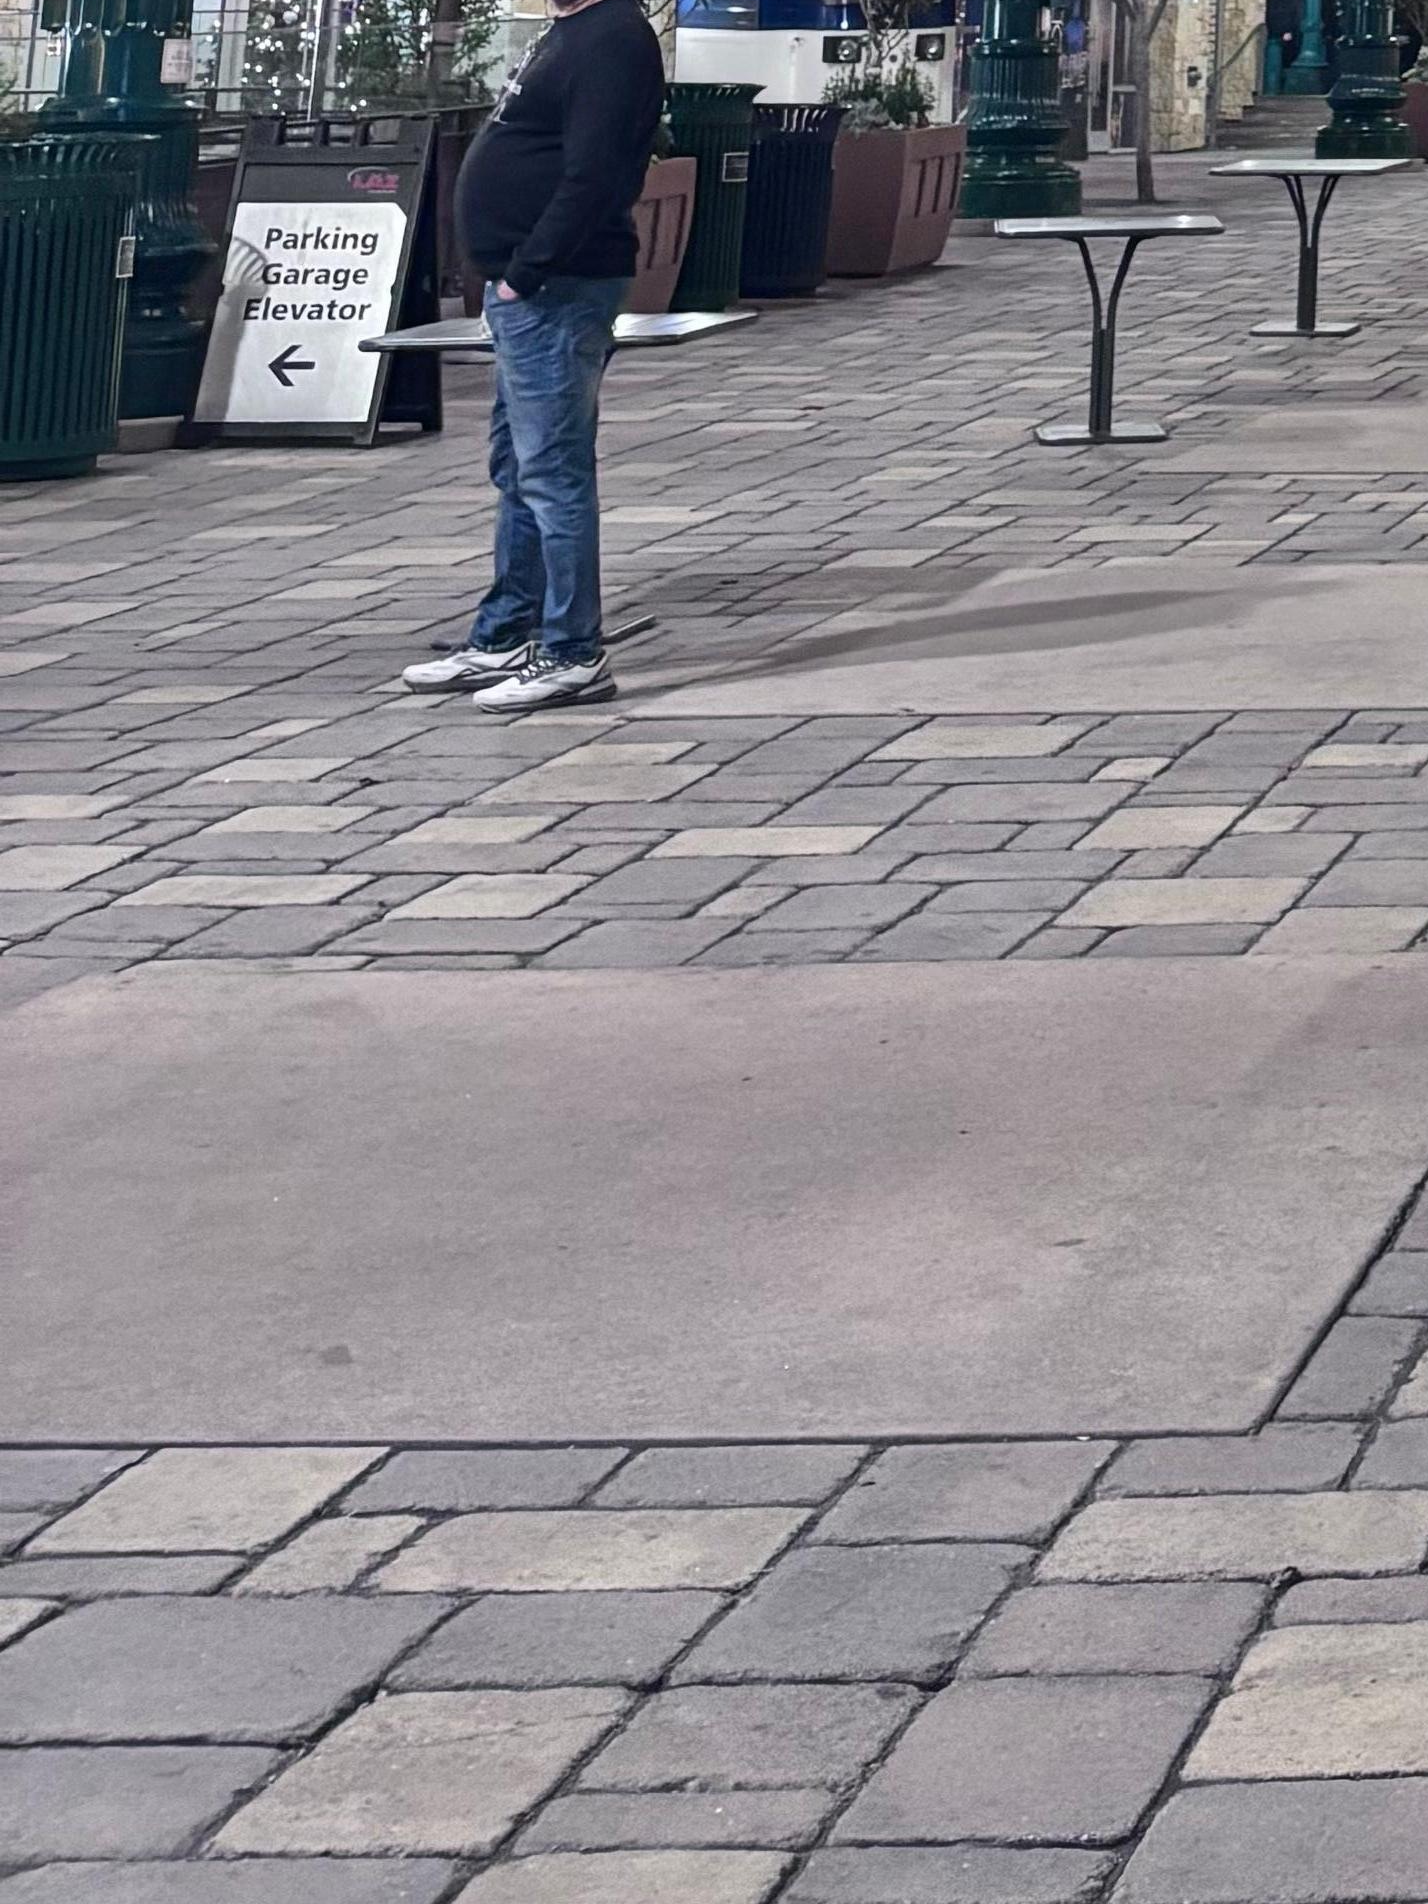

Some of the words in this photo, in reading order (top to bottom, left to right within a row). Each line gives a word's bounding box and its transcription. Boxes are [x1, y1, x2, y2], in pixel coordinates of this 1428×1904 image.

[264, 226, 379, 256] Parking
[261, 263, 369, 290] Garage
[243, 297, 372, 321] Elevator
